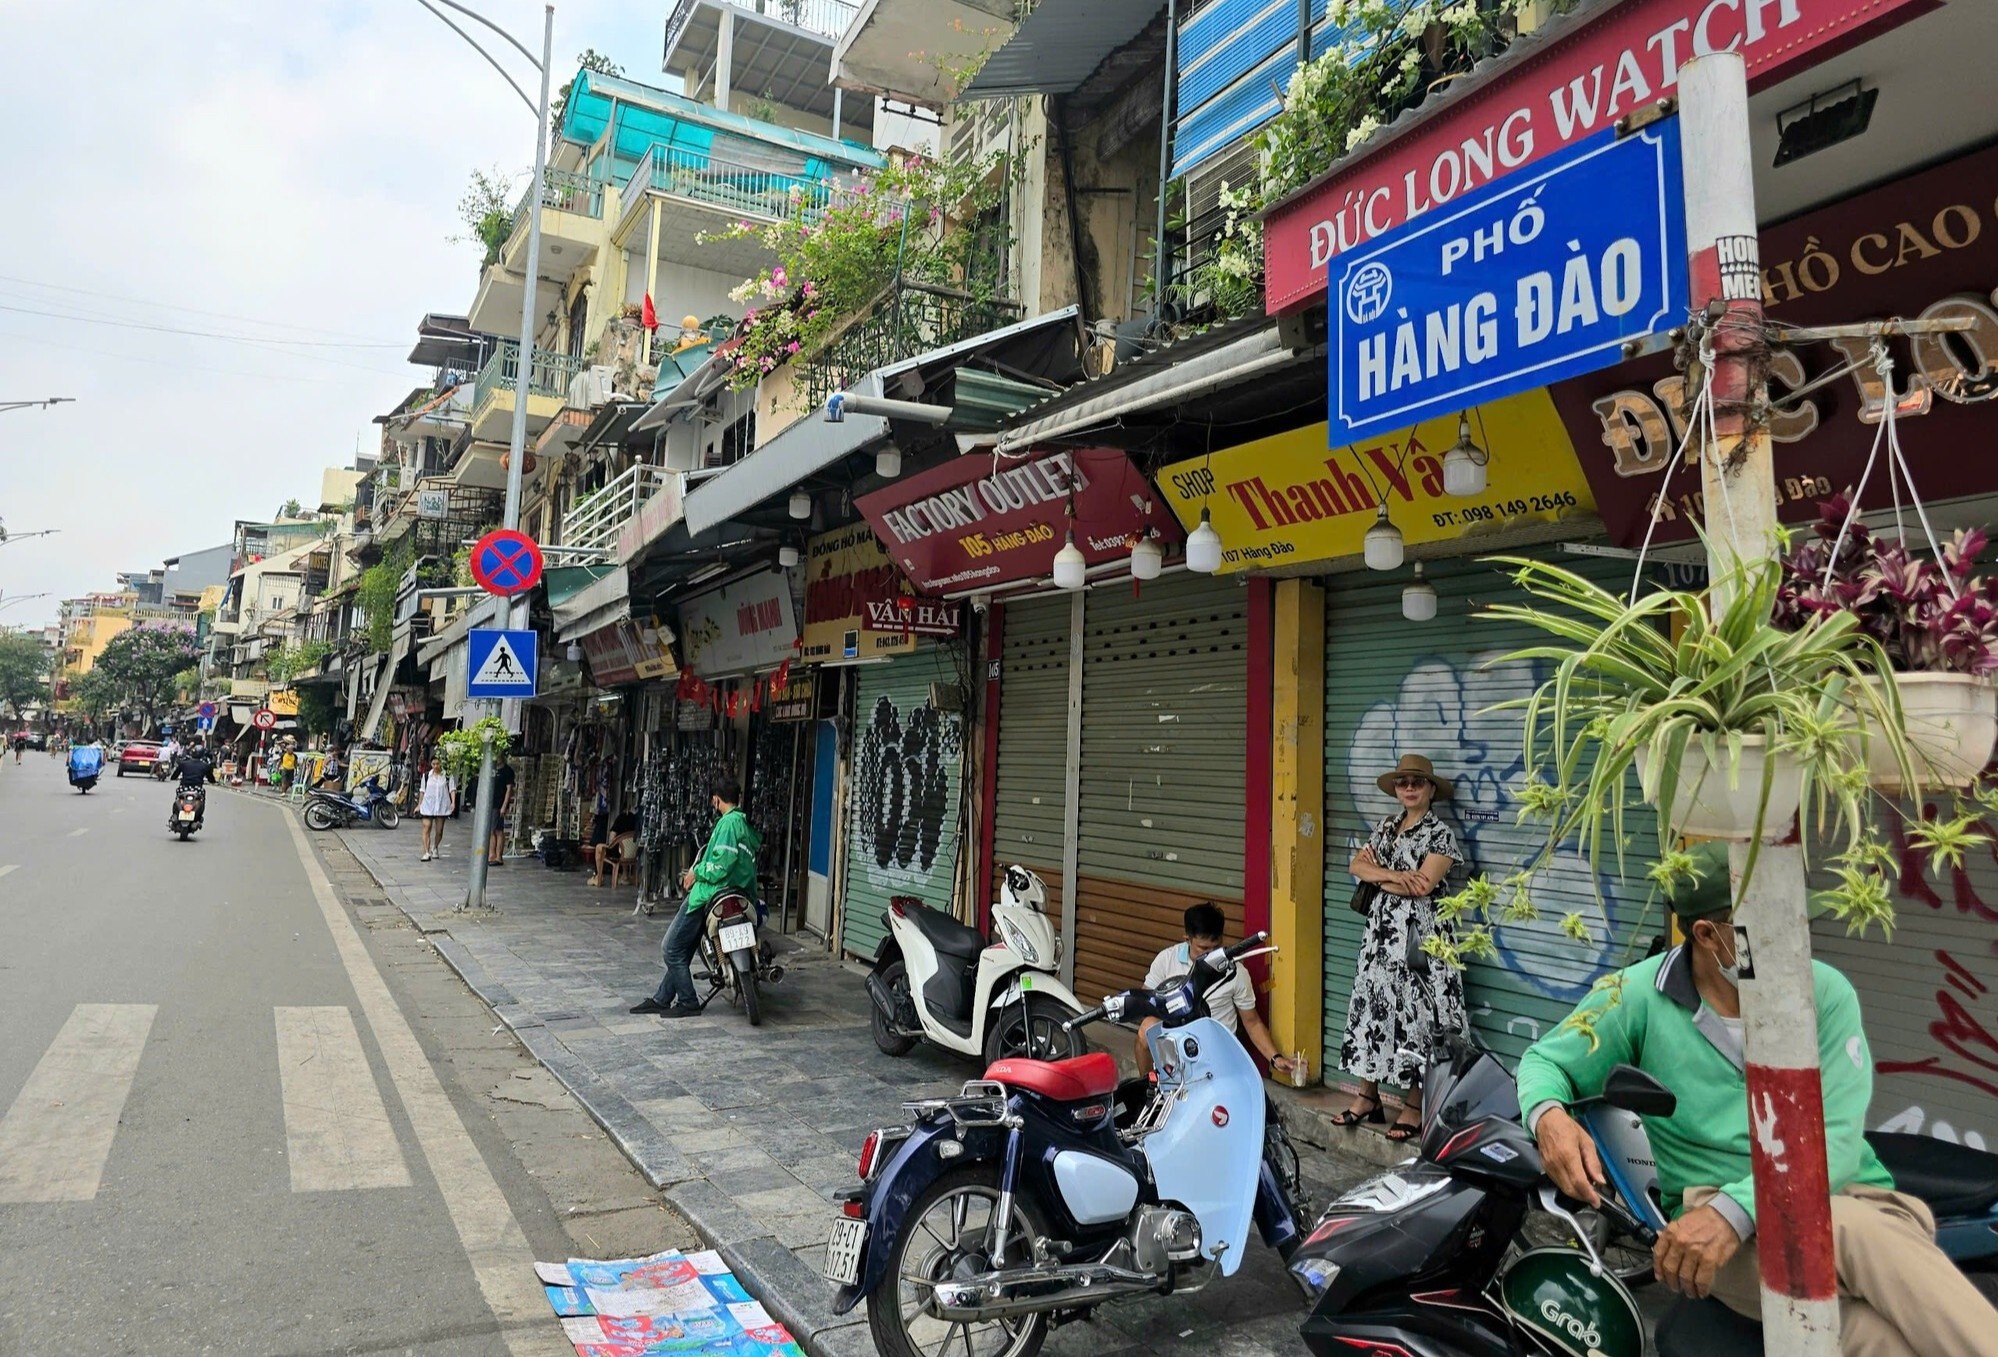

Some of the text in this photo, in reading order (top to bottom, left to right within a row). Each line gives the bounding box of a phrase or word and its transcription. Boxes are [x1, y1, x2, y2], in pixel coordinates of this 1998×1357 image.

[1309, 0, 1800, 270] ĐỨC LONG WATCH
[1442, 183, 1547, 276] PHỐ
[1850, 204, 1981, 275] CAO
[1359, 237, 1642, 401] HÀNG ĐÀO
[882, 452, 1082, 544] FACTORY OUTLET
[1171, 467, 1217, 500] SHOP
[1226, 437, 1491, 532] Thanh Vâ
[1432, 491, 1577, 528] ĐT: 098 149 2646
[958, 522, 1055, 559] 105 HÀNG ĐÀO
[1221, 541, 1295, 563] 107 Hàng Đào
[1626, 1157, 1656, 1167] HOND
[1540, 1299, 1602, 1348] Grab
